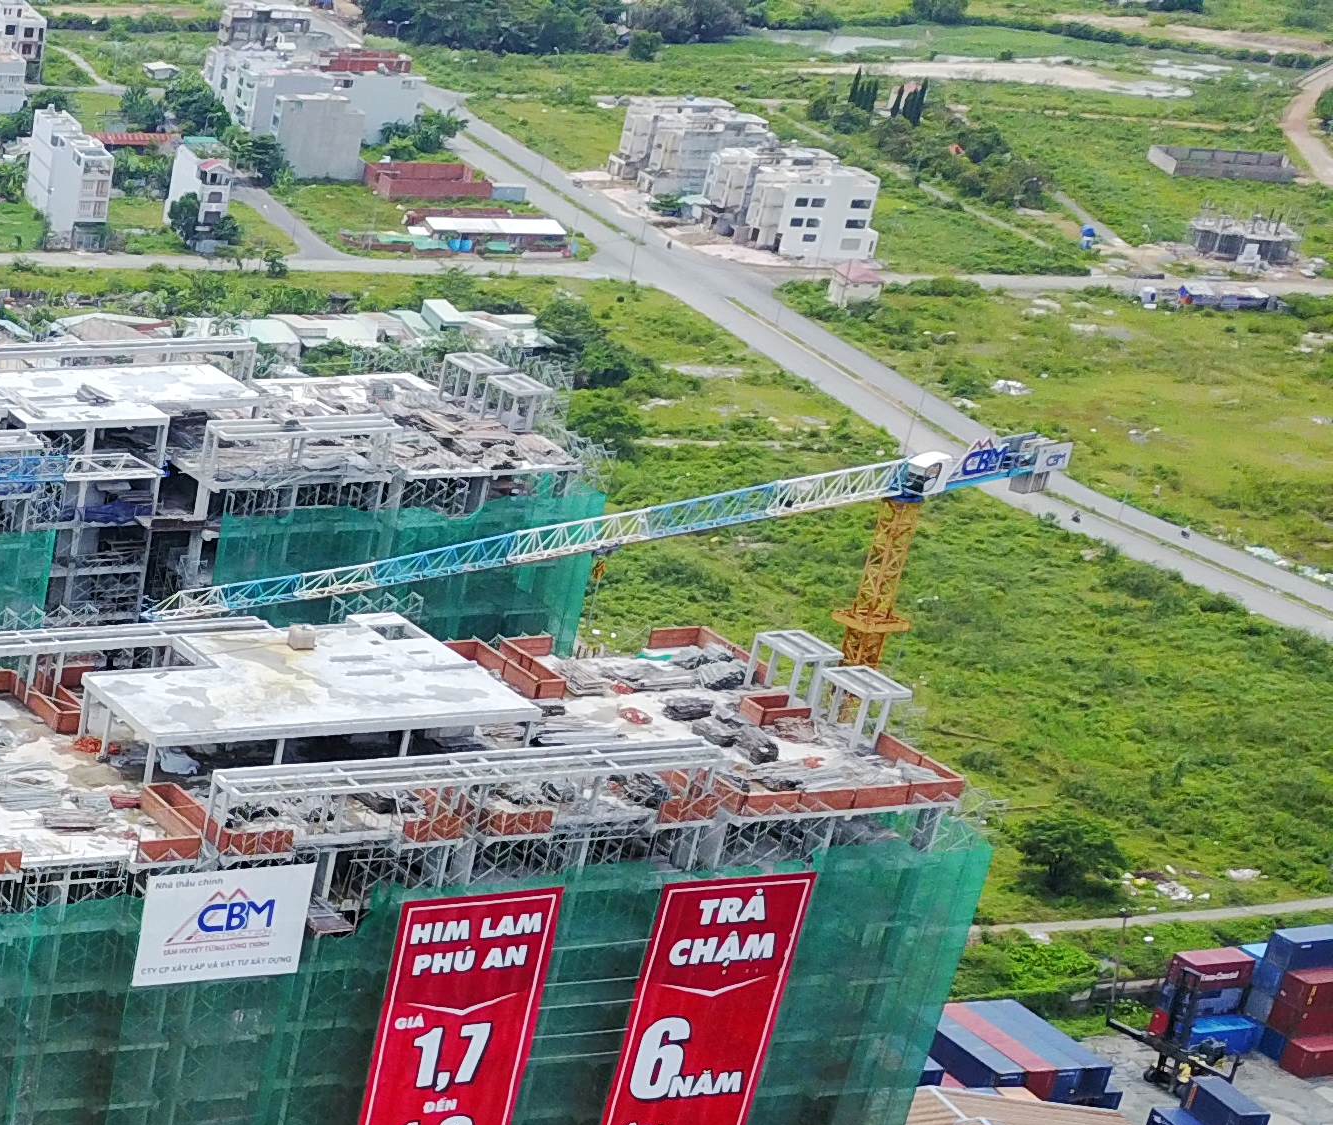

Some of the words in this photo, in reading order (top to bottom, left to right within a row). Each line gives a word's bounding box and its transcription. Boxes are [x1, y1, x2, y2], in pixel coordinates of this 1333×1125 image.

[197, 899, 275, 932] CBM
[699, 888, 765, 926] TRẢ
[410, 919, 469, 944] HIM
[480, 912, 543, 938] LAM
[411, 946, 475, 976] PHÚ
[481, 945, 527, 970] AN
[669, 930, 775, 970] CHẬM
[394, 1012, 425, 1030] GIÁ
[413, 1022, 491, 1092] 1,7
[629, 1017, 691, 1100] 6
[668, 1070, 743, 1098] NĂM
[423, 1096, 457, 1114] ĐẾN
